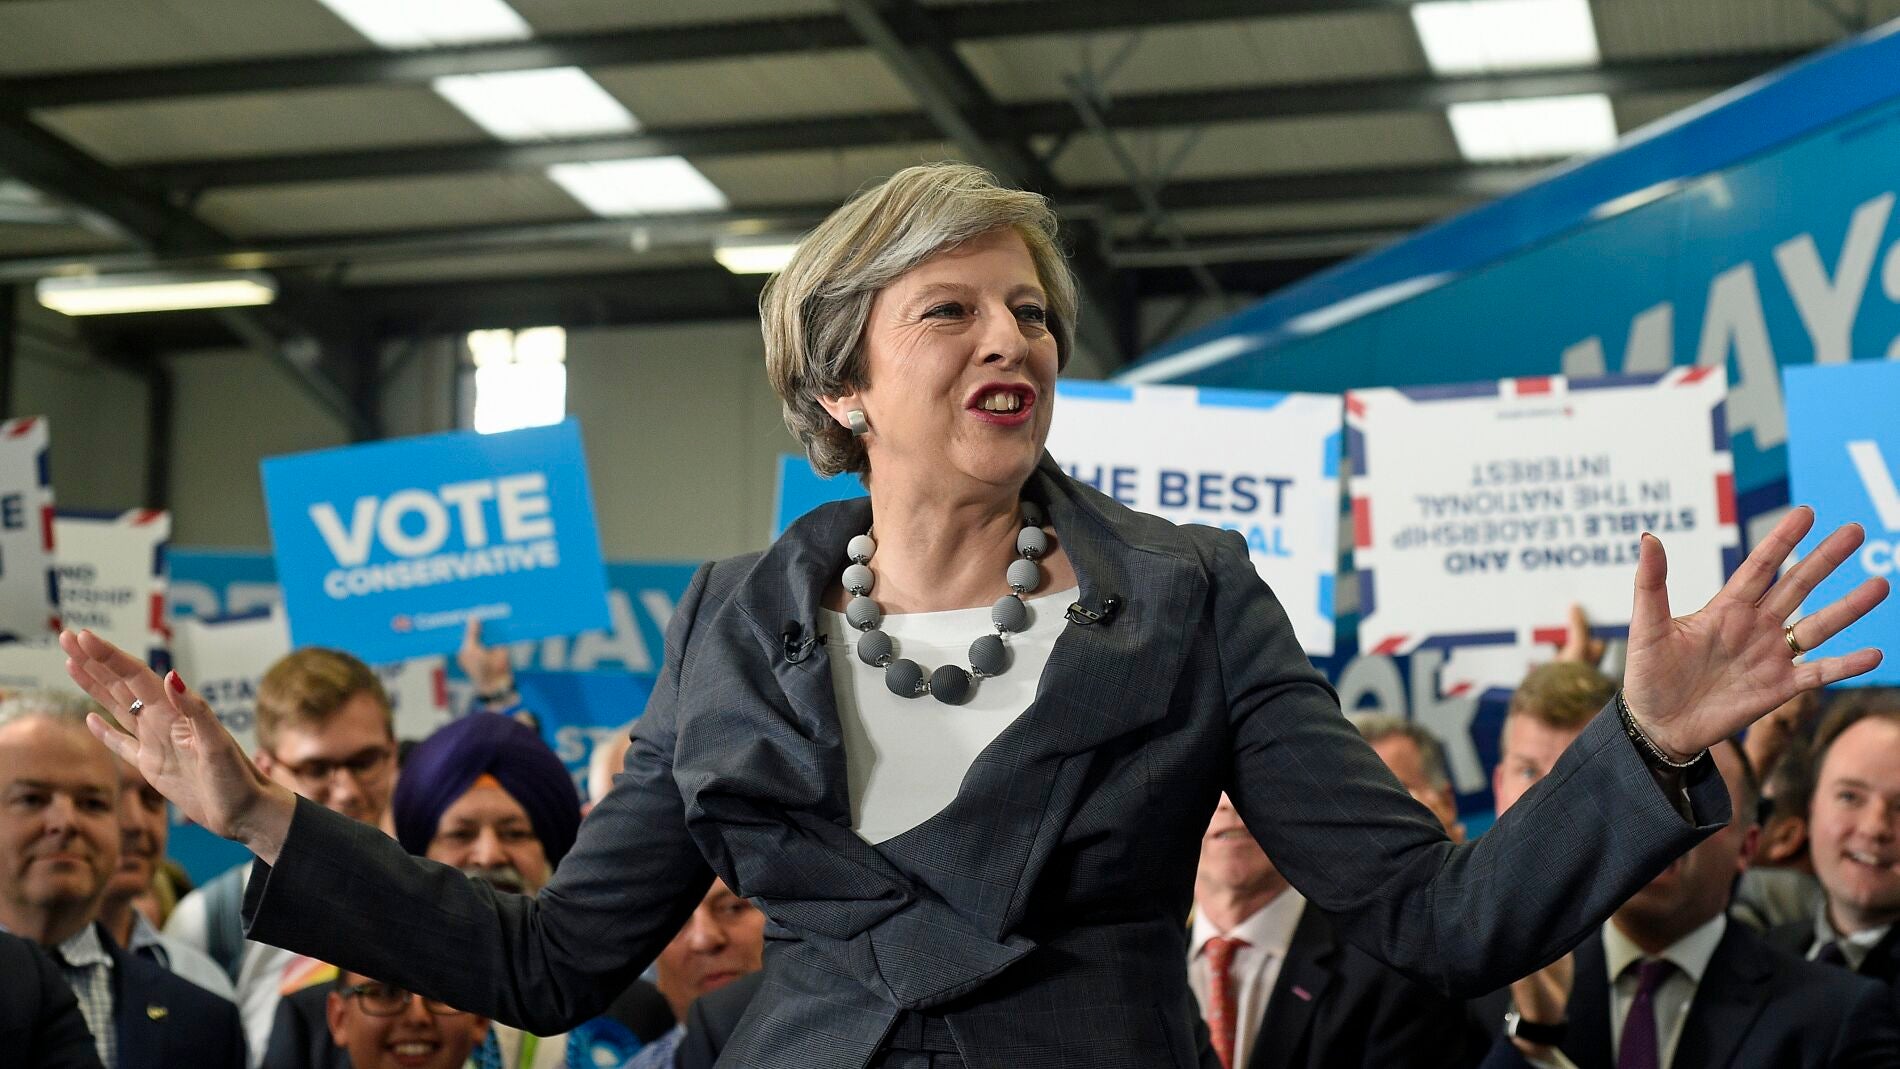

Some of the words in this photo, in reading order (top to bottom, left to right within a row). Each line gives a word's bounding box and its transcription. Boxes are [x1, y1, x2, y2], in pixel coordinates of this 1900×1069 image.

[1470, 454, 1611, 487] INTEREST
[1060, 462, 1138, 507] HE
[1159, 470, 1294, 515] BEST
[1413, 488, 1565, 517] NATIONAL
[1574, 485, 1631, 509] THE
[1639, 480, 1671, 505] IN
[310, 473, 554, 567] VOTE
[1391, 516, 1576, 551] LEADERSHIP
[1584, 507, 1698, 538] STABLE
[325, 541, 558, 598] CONSERVATIVE
[1444, 550, 1510, 576] AND
[1519, 542, 1642, 571] STRONG
